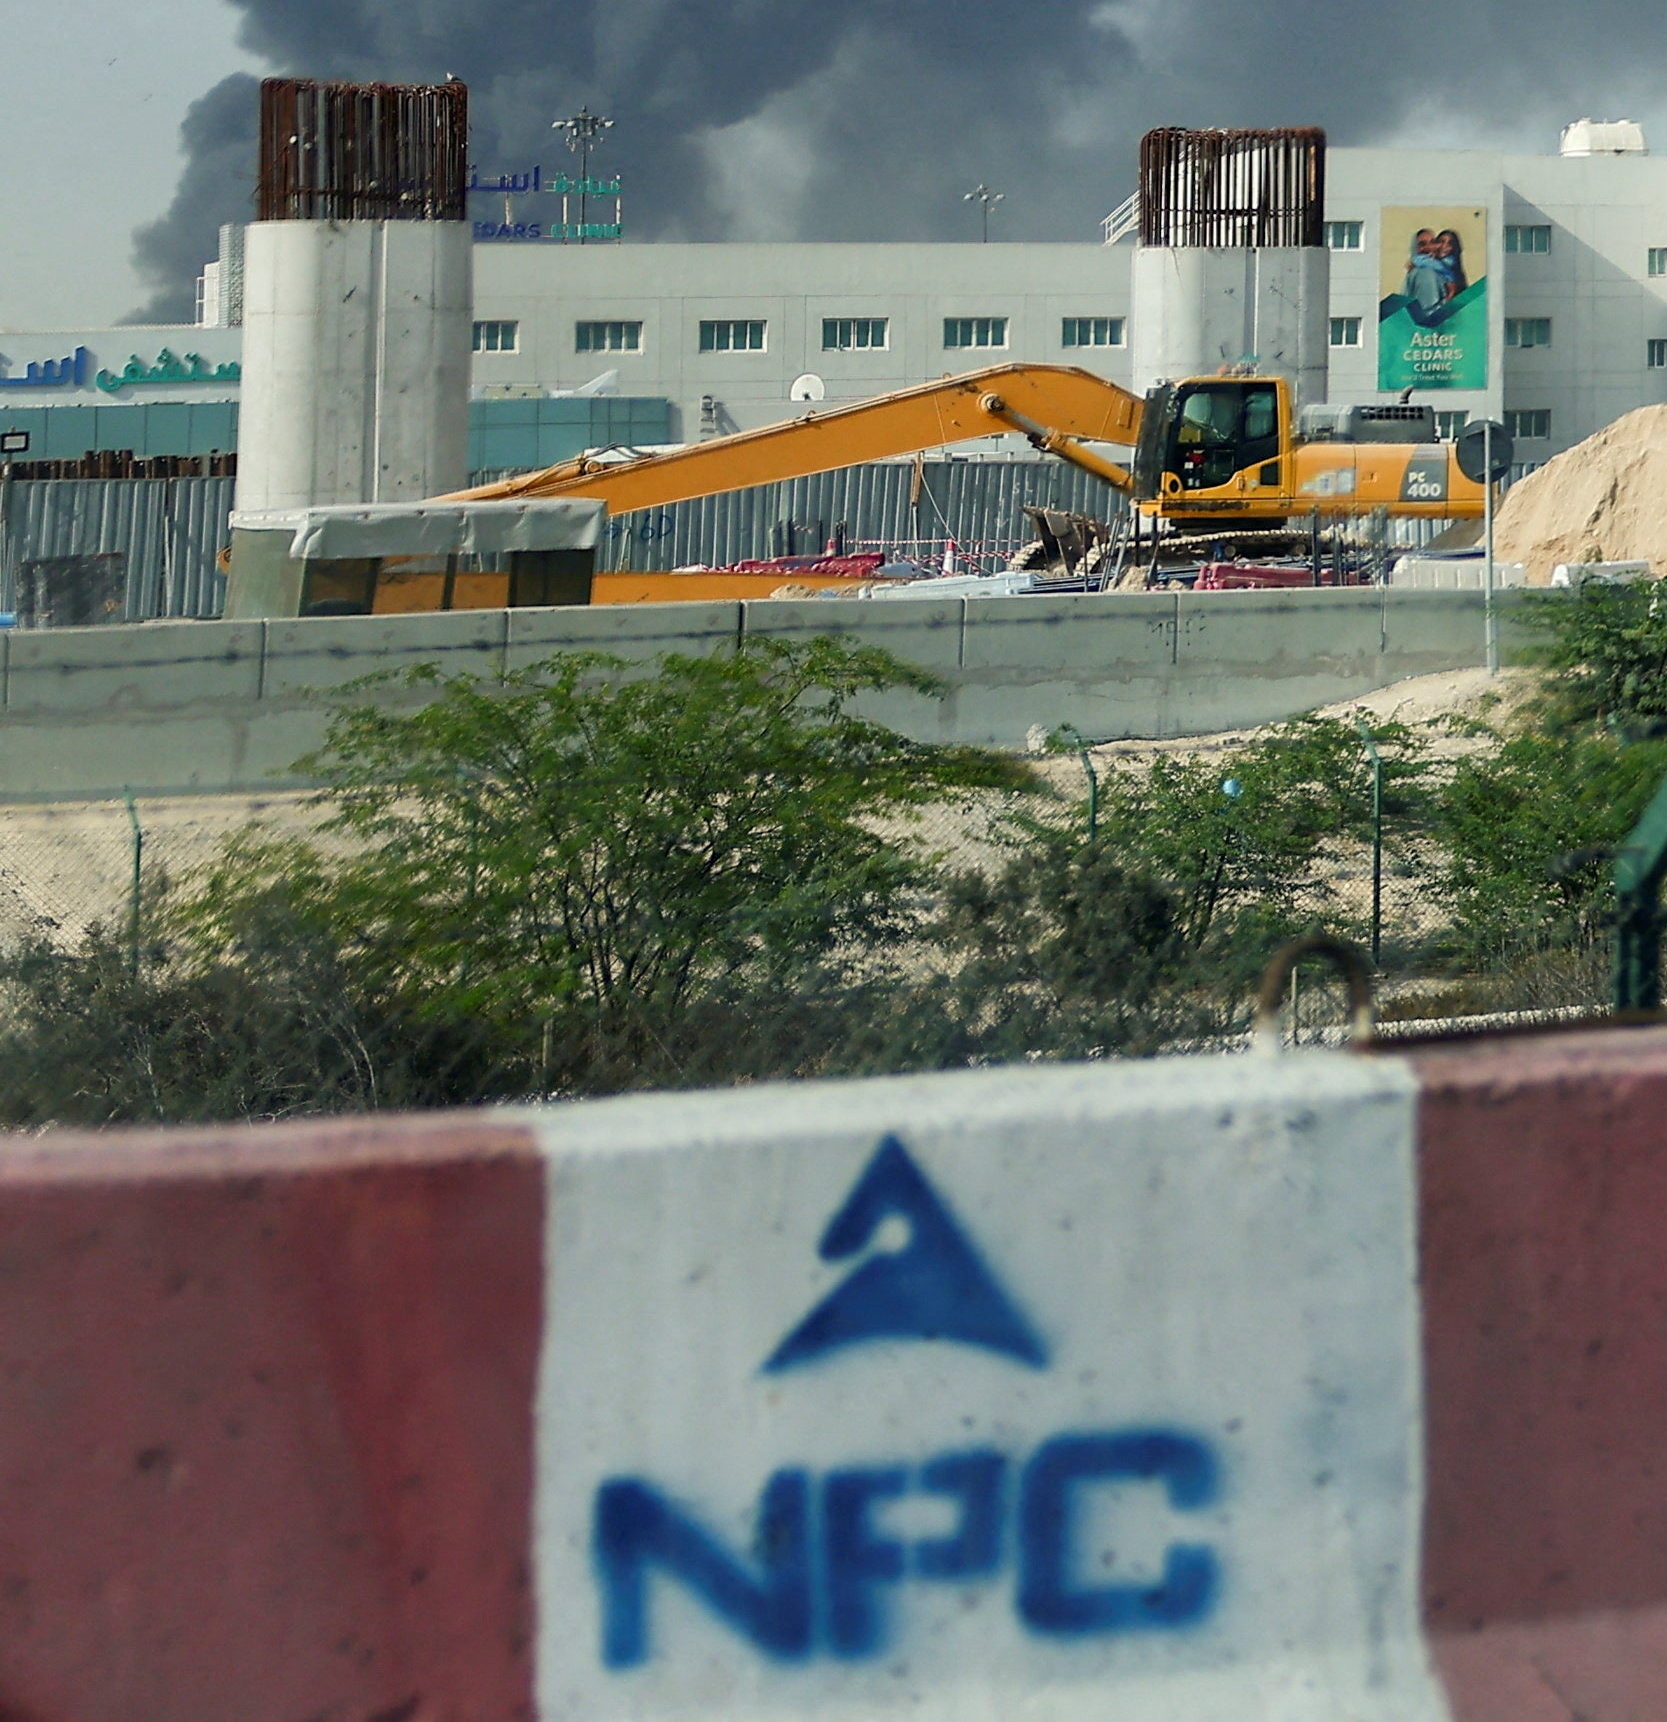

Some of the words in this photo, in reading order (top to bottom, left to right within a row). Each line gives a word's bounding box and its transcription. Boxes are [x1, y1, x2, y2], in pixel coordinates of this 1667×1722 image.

[473, 222, 541, 239] EDARS
[551, 223, 624, 239] CLINIC
[1410, 332, 1456, 347] Aster
[1403, 349, 1463, 361] CEDARS
[1413, 362, 1452, 372] CLINIC
[1408, 472, 1426, 483] PC
[1407, 483, 1441, 497] 400
[590, 1424, 1221, 1671] NPC
